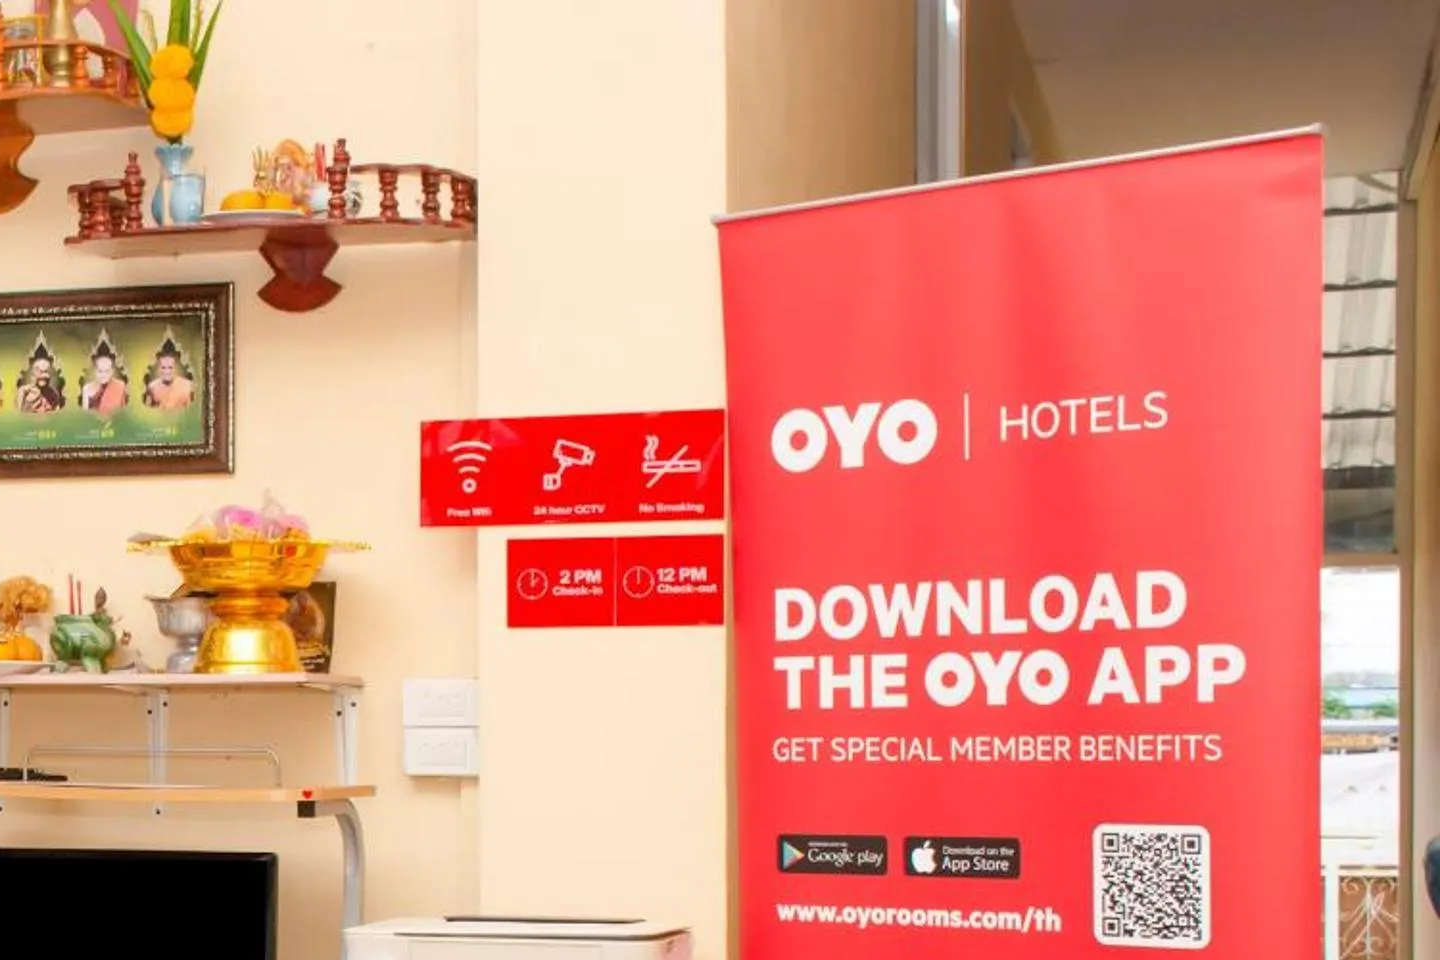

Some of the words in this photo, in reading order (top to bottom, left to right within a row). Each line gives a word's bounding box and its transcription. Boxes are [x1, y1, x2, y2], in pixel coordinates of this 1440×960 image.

[999, 390, 1169, 442] HOTELS
[771, 398, 938, 473] OYO
[574, 503, 606, 514] CCTV
[560, 570, 571, 584] 2
[574, 569, 602, 584] PM
[657, 568, 675, 582] 12
[679, 566, 708, 581] PM
[552, 585, 604, 596] Check-in
[656, 583, 717, 594] Check-out
[774, 570, 1187, 642] DOWNLOAD
[774, 654, 908, 709] THE
[924, 650, 1070, 707] OYO
[1088, 643, 1247, 705] APP
[772, 736, 824, 762] GET
[830, 735, 943, 762] SPECIAL
[950, 735, 1071, 761] MEMBER
[1079, 734, 1223, 761] BENEFITS
[807, 848, 854, 867] Google
[857, 849, 884, 867] play
[942, 845, 985, 856] Download
[986, 848, 999, 856] on
[1000, 846, 1015, 857] the
[942, 856, 971, 872] App
[973, 857, 1010, 872] Store
[776, 903, 1063, 933] www.oyorooms.com/th
